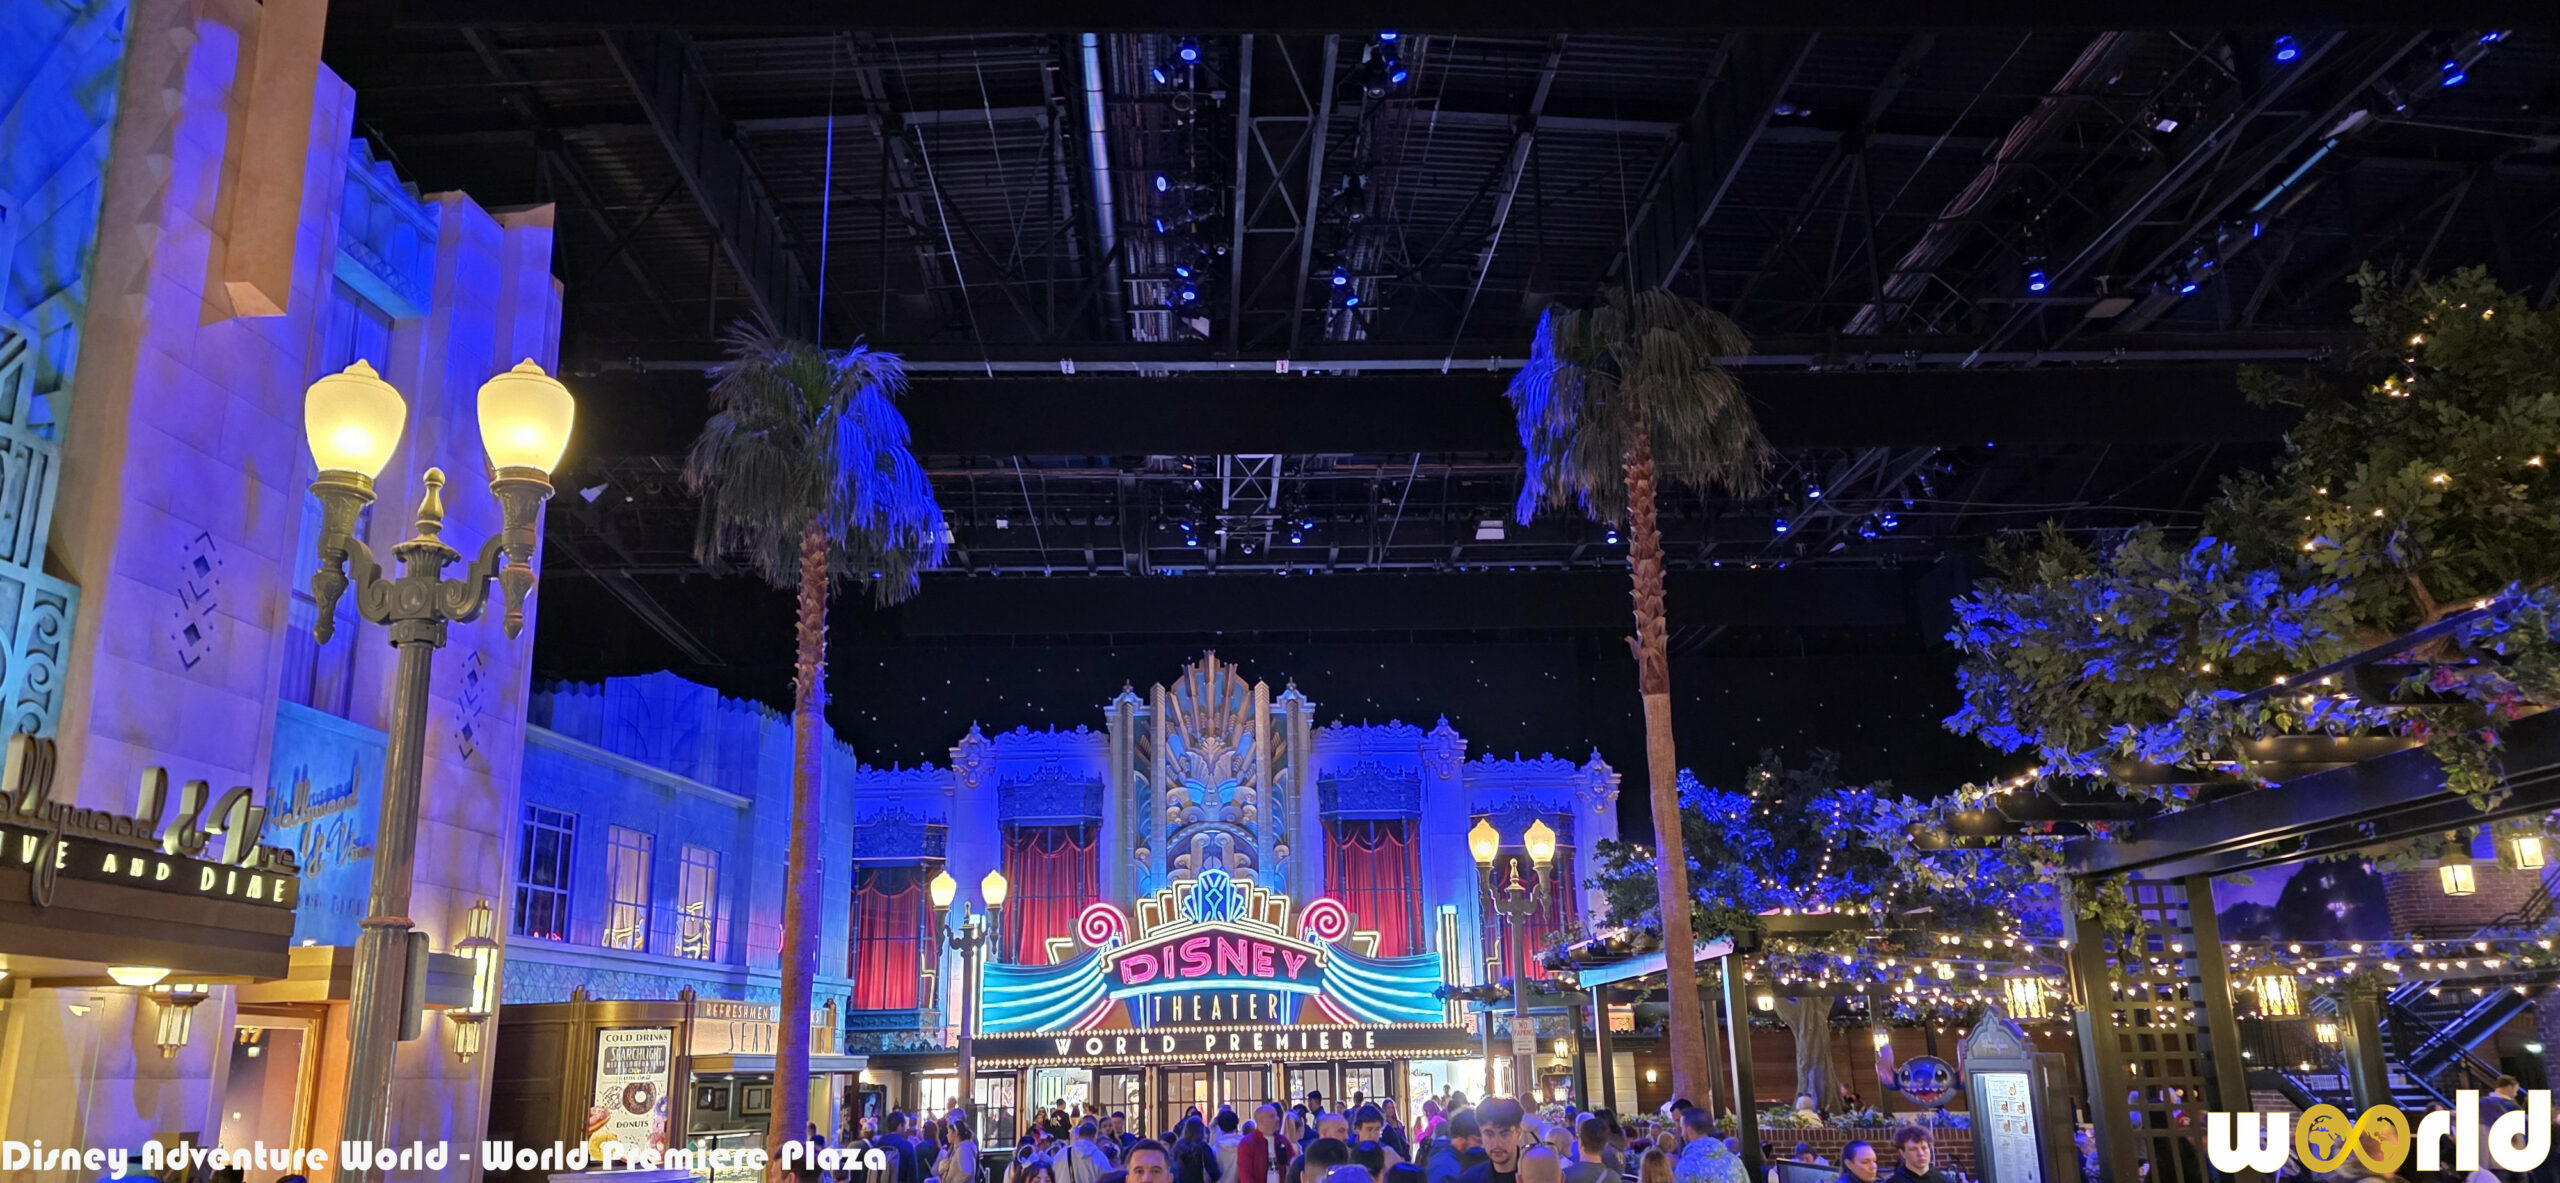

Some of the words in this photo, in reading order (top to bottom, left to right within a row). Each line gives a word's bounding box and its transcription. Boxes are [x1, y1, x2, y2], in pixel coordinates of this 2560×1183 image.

[162, 779, 209, 856] &
[266, 765, 361, 858] Hollywood
[102, 853, 170, 881] AND
[200, 866, 287, 903] DINE
[1120, 936, 1307, 985] DISNEY
[706, 1003, 778, 1020] REFRESHMENTS
[1154, 993, 1279, 1022] THEATER
[606, 1034, 633, 1042] COLD
[636, 1033, 668, 1042] DRINKS
[1055, 1035, 1176, 1056] WORLD
[1205, 1031, 1375, 1052] PREMIERE
